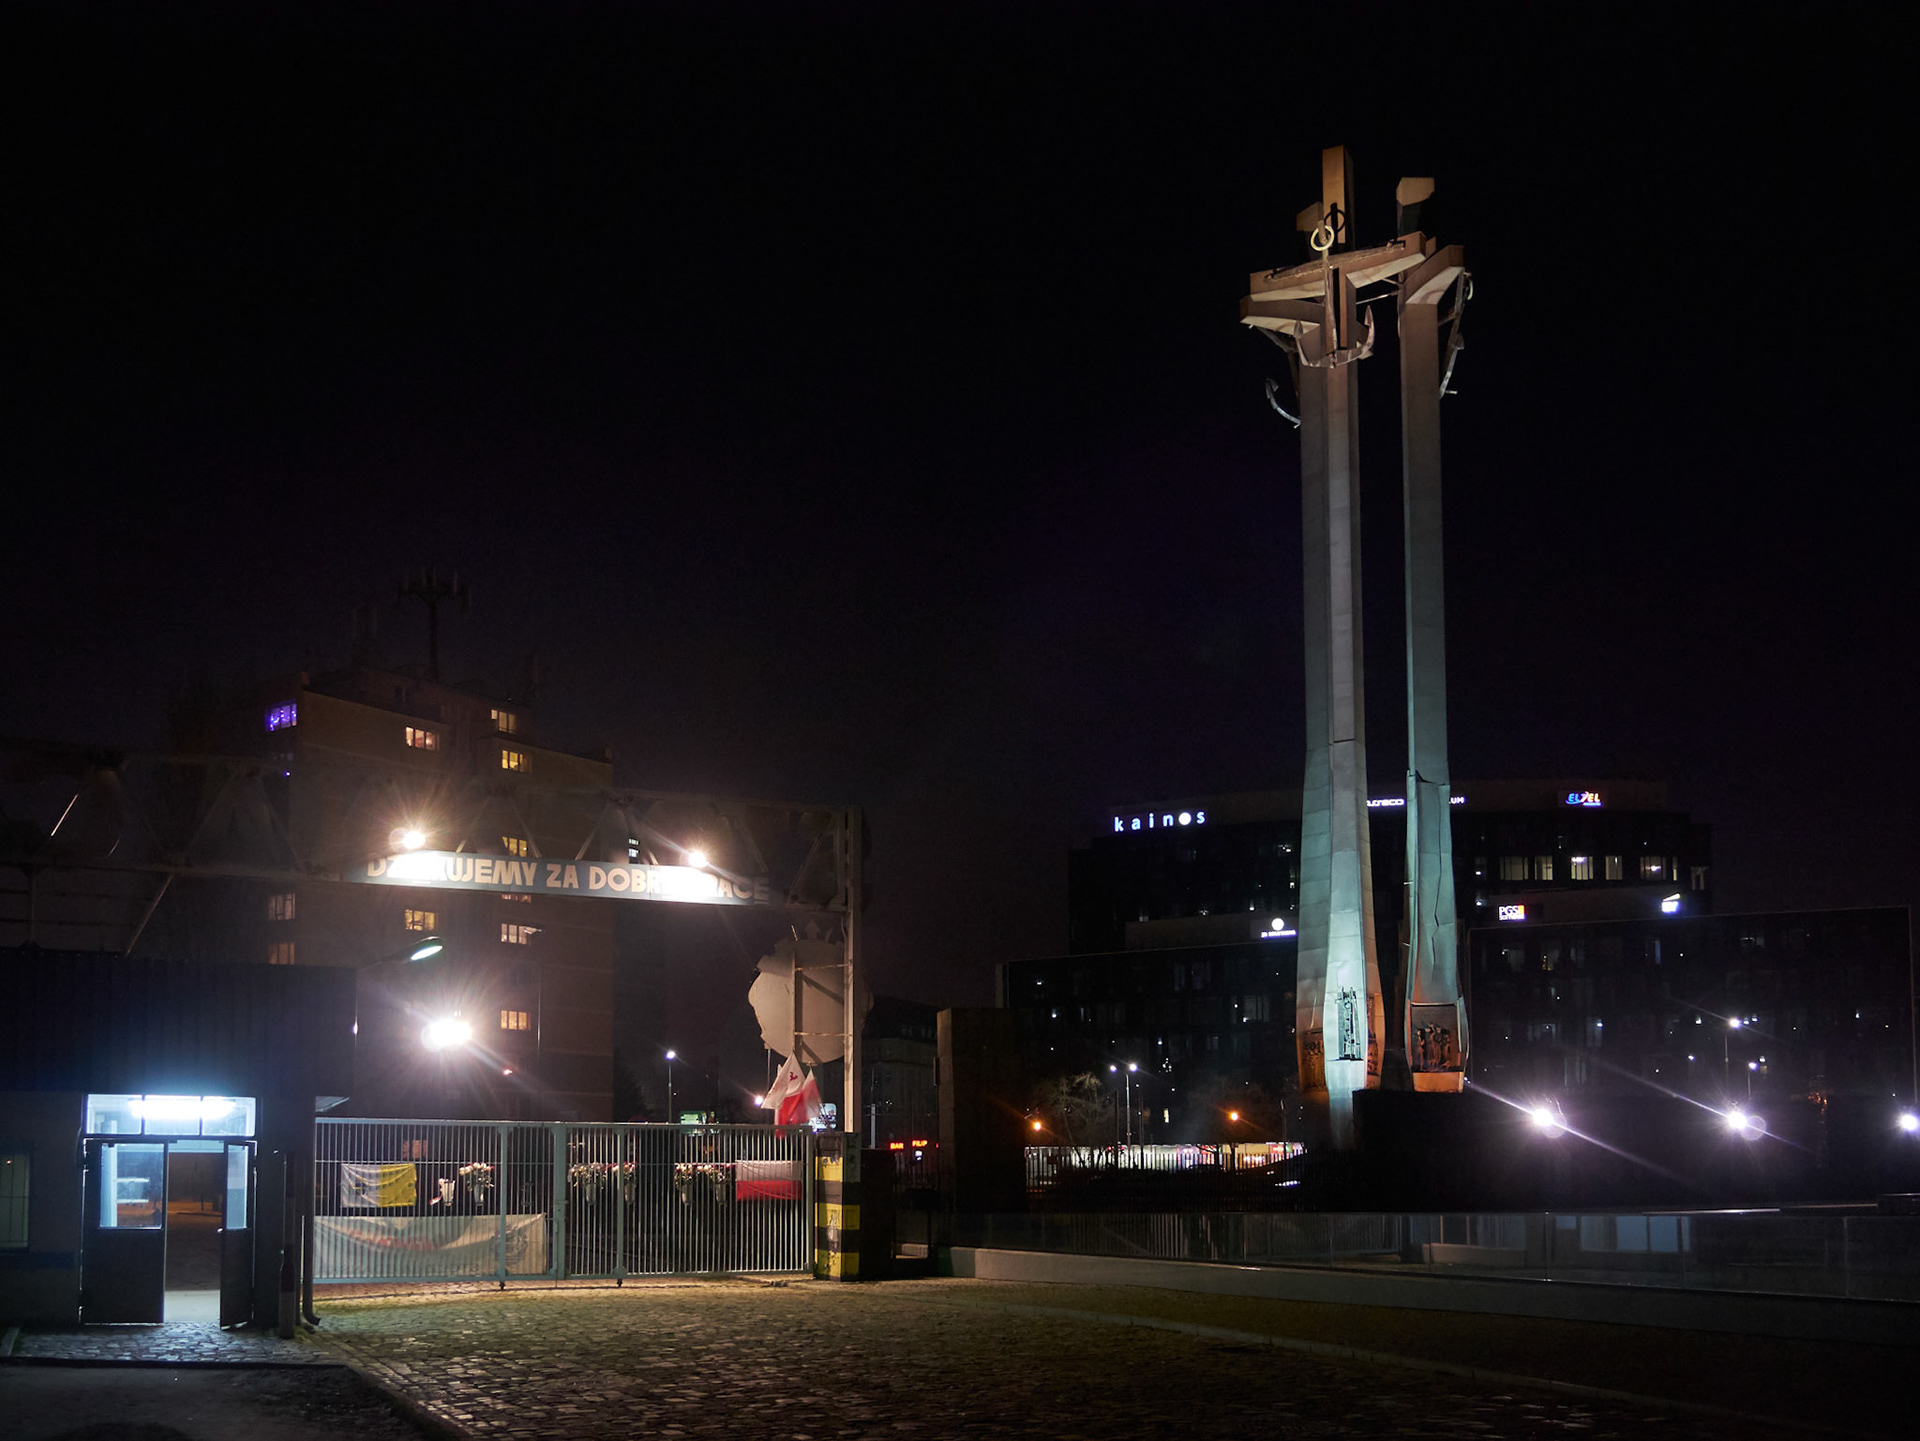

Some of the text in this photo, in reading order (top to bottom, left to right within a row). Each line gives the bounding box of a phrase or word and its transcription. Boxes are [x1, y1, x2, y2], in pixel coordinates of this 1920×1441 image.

[1114, 811, 1206, 832] kainos
[366, 856, 537, 886] DUJEMY
[546, 864, 579, 889] ZA
[588, 865, 680, 897] DOBR
